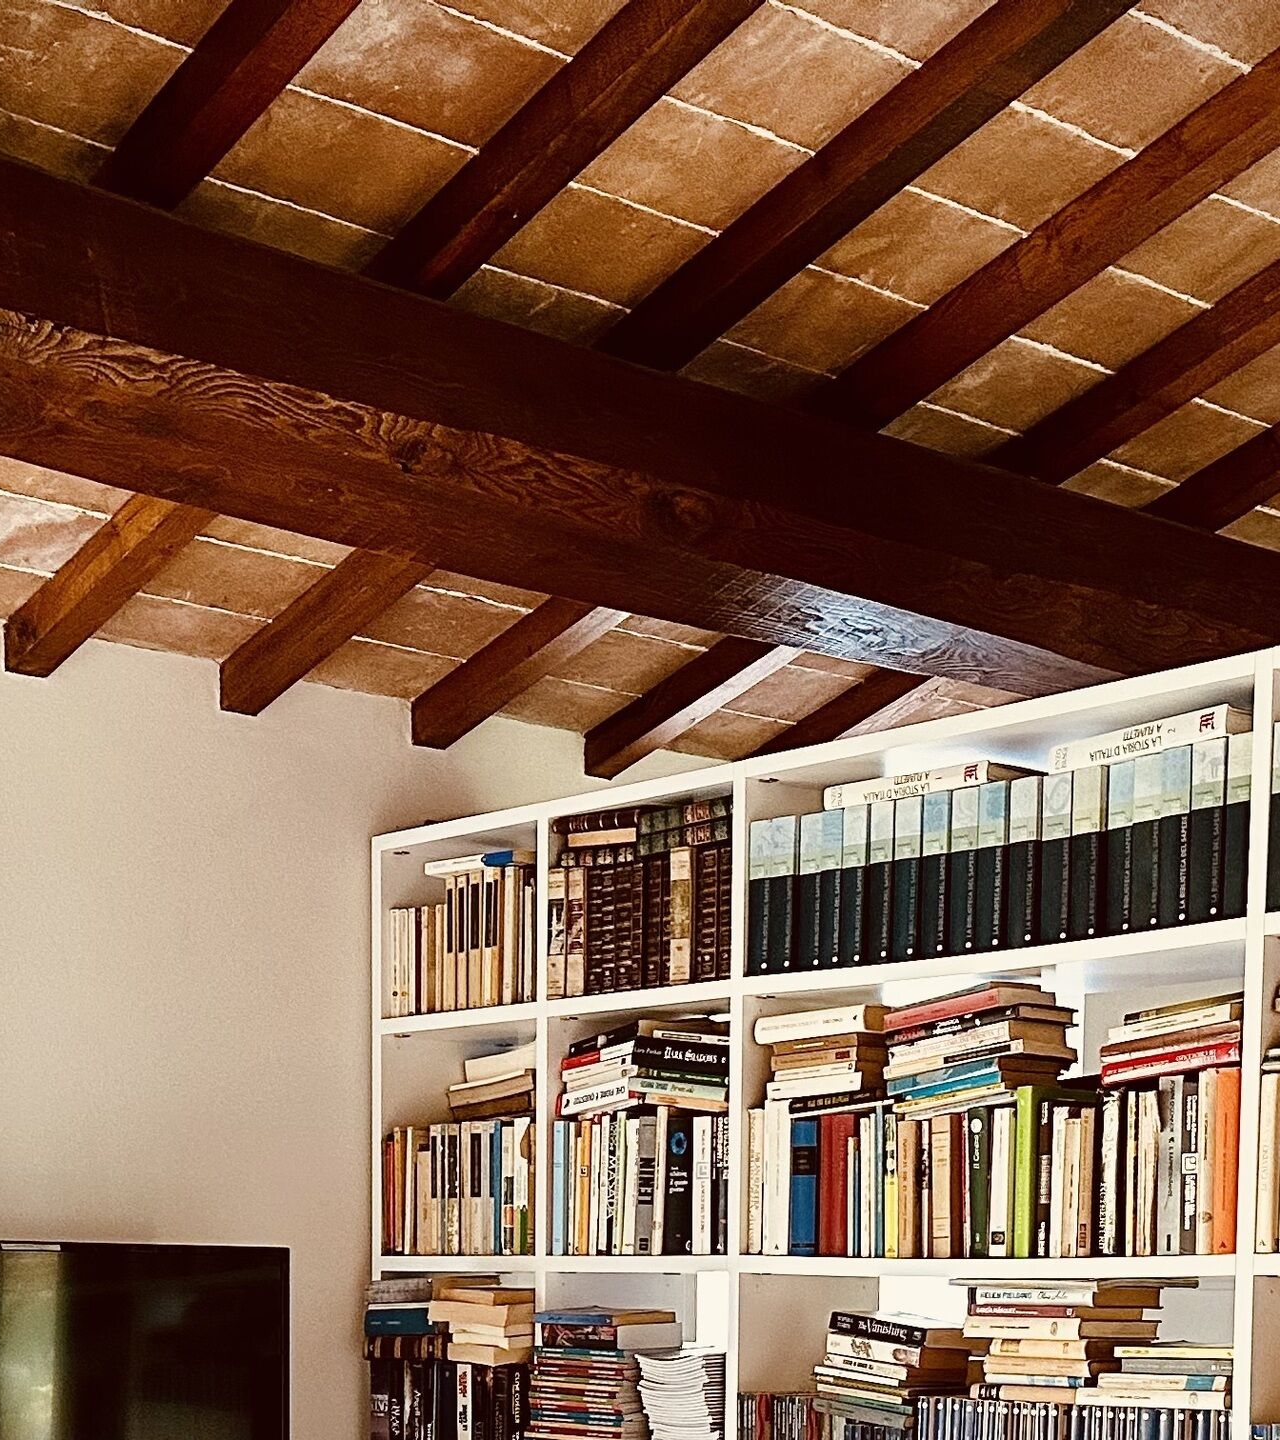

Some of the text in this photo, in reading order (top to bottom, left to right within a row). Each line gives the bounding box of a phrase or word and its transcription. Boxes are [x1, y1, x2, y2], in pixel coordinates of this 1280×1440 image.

[1122, 739, 1151, 755] STORIA
[1152, 737, 1162, 748] LA
[894, 786, 919, 800] STORIA
[920, 784, 930, 794] LA
[608, 1155, 617, 1220] MASADA
[639, 1157, 655, 1205] LENIN
[867, 1319, 908, 1341] Vanishing
